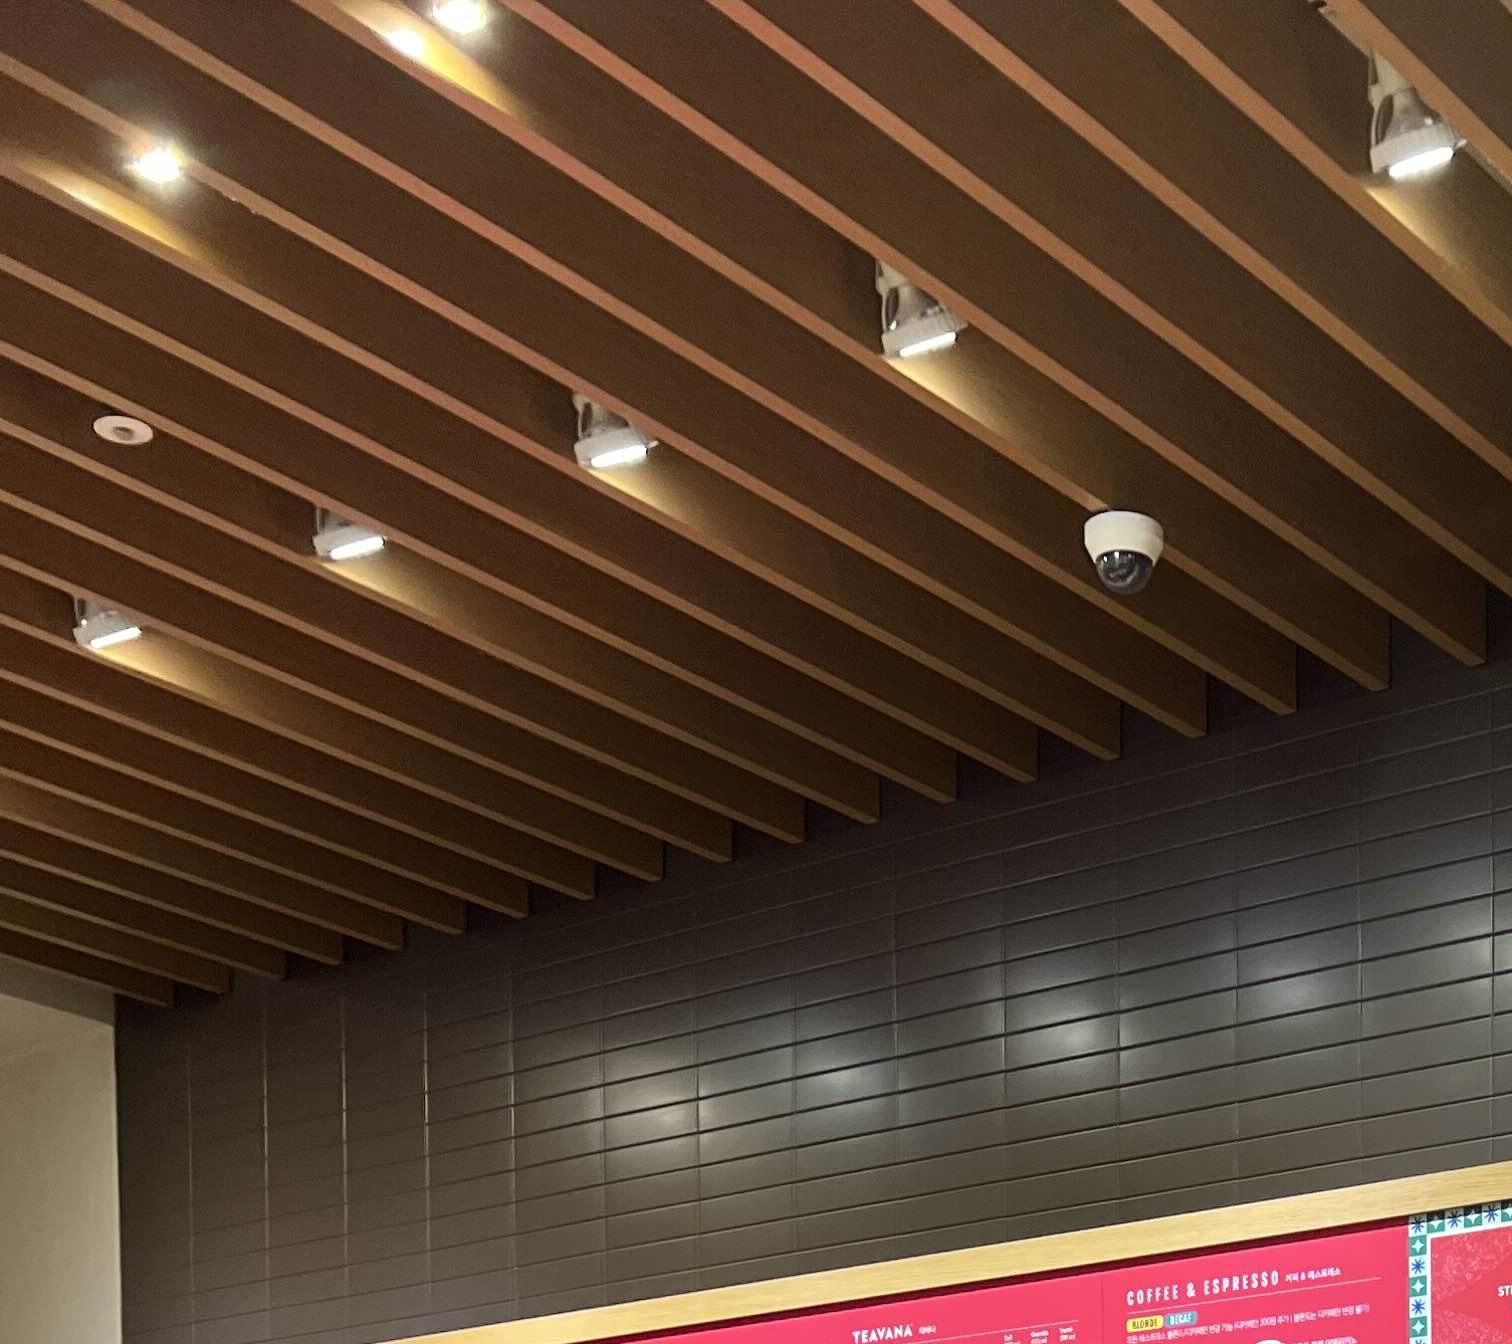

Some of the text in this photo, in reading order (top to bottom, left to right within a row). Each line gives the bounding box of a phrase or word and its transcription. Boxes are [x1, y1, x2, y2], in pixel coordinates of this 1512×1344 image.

[1127, 1285, 1179, 1306] COFFEE
[1186, 1283, 1196, 1298] &
[1204, 1270, 1279, 1295] ESPRESSO
[1132, 1319, 1158, 1329] BLONDE
[1169, 1314, 1193, 1324] DECAF
[852, 1325, 913, 1344] TEAVANA
